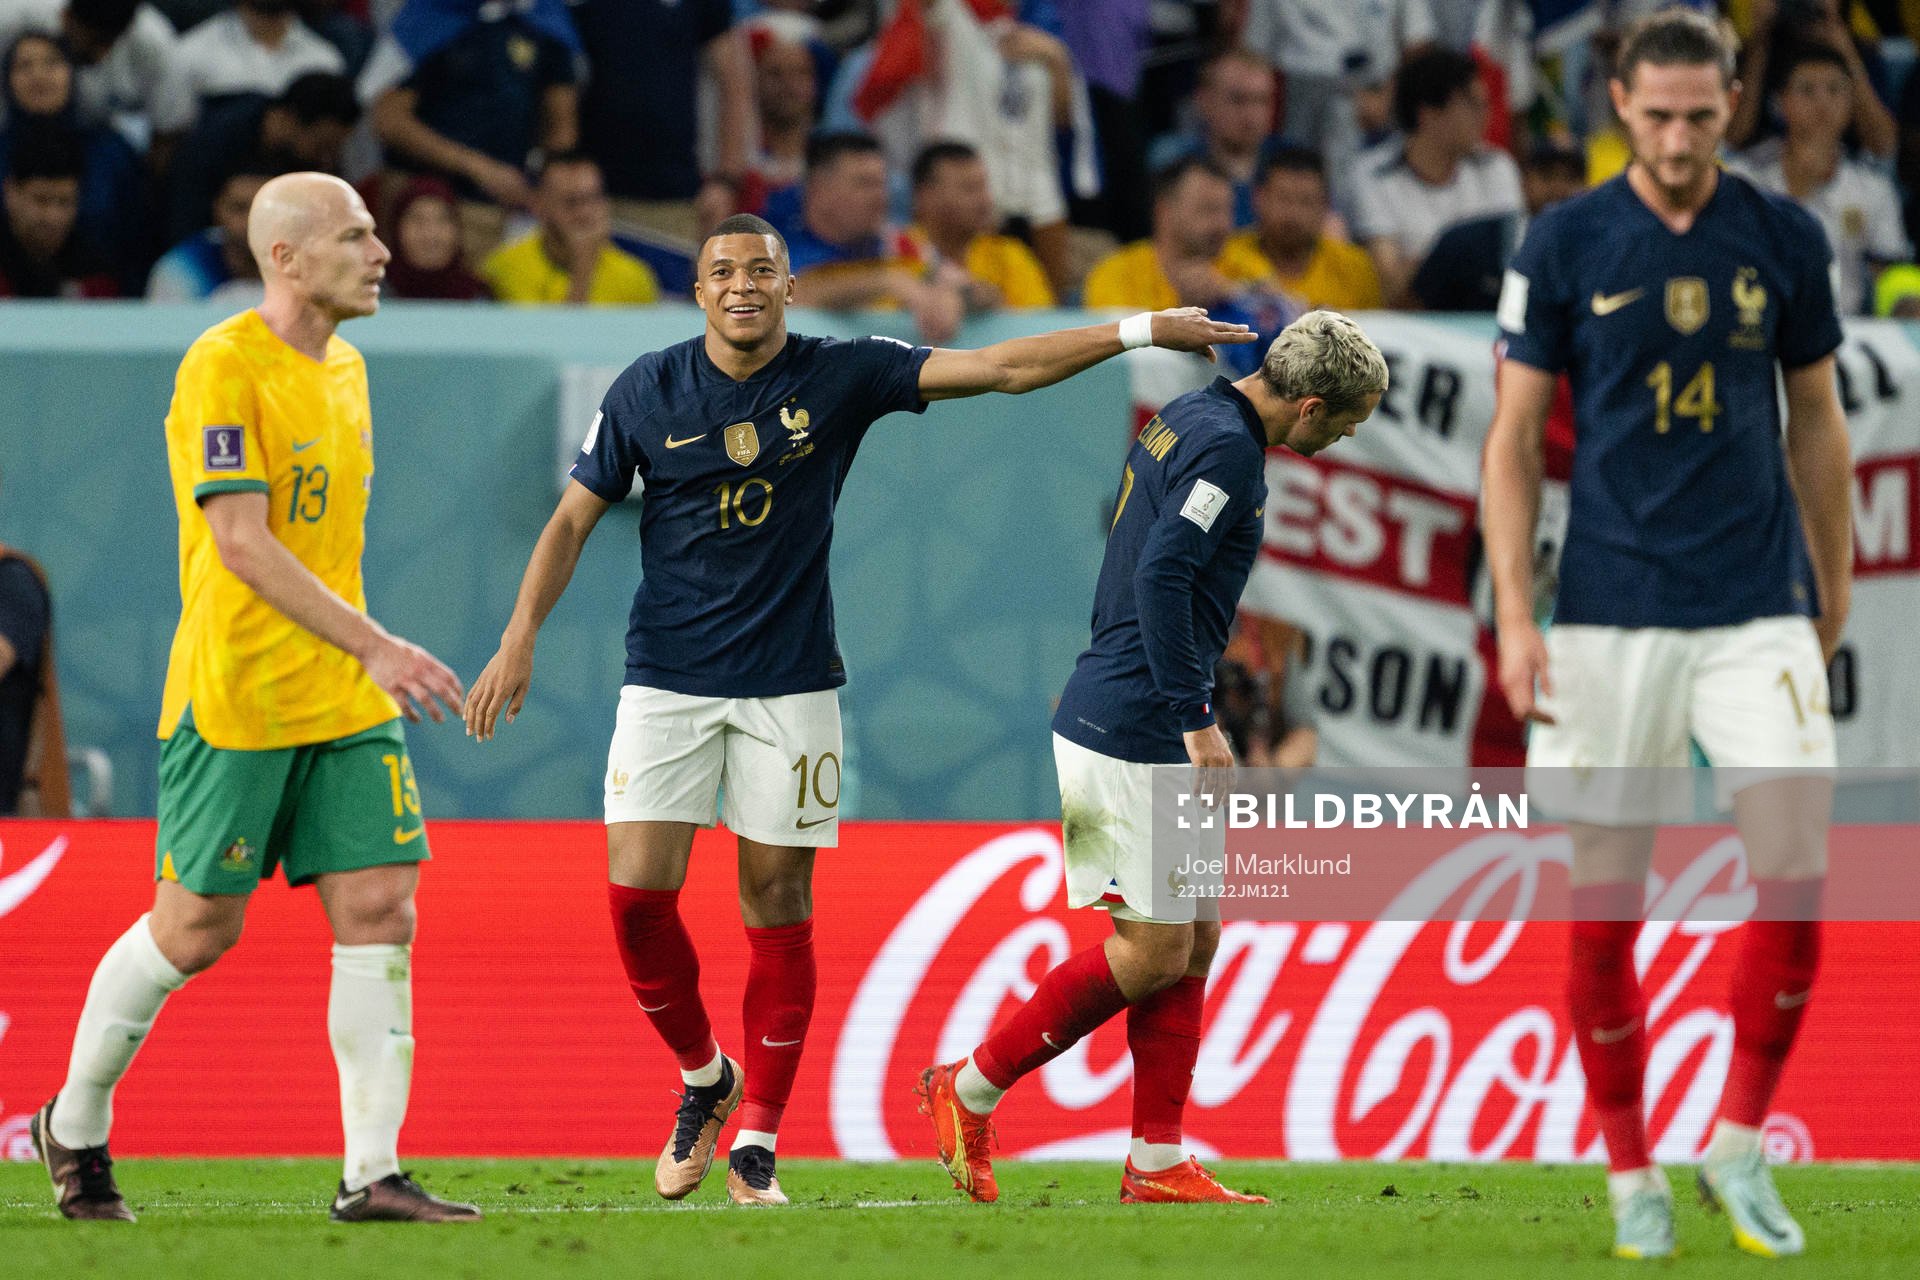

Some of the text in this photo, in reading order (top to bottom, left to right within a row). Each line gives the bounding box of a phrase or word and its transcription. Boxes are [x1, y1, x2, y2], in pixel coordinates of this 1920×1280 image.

[1647, 361, 1721, 435] 14
[288, 464, 329, 524] 13
[712, 477, 773, 529] 10
[1299, 630, 1468, 733] SON
[382, 753, 422, 817] 13
[791, 751, 841, 809] 10
